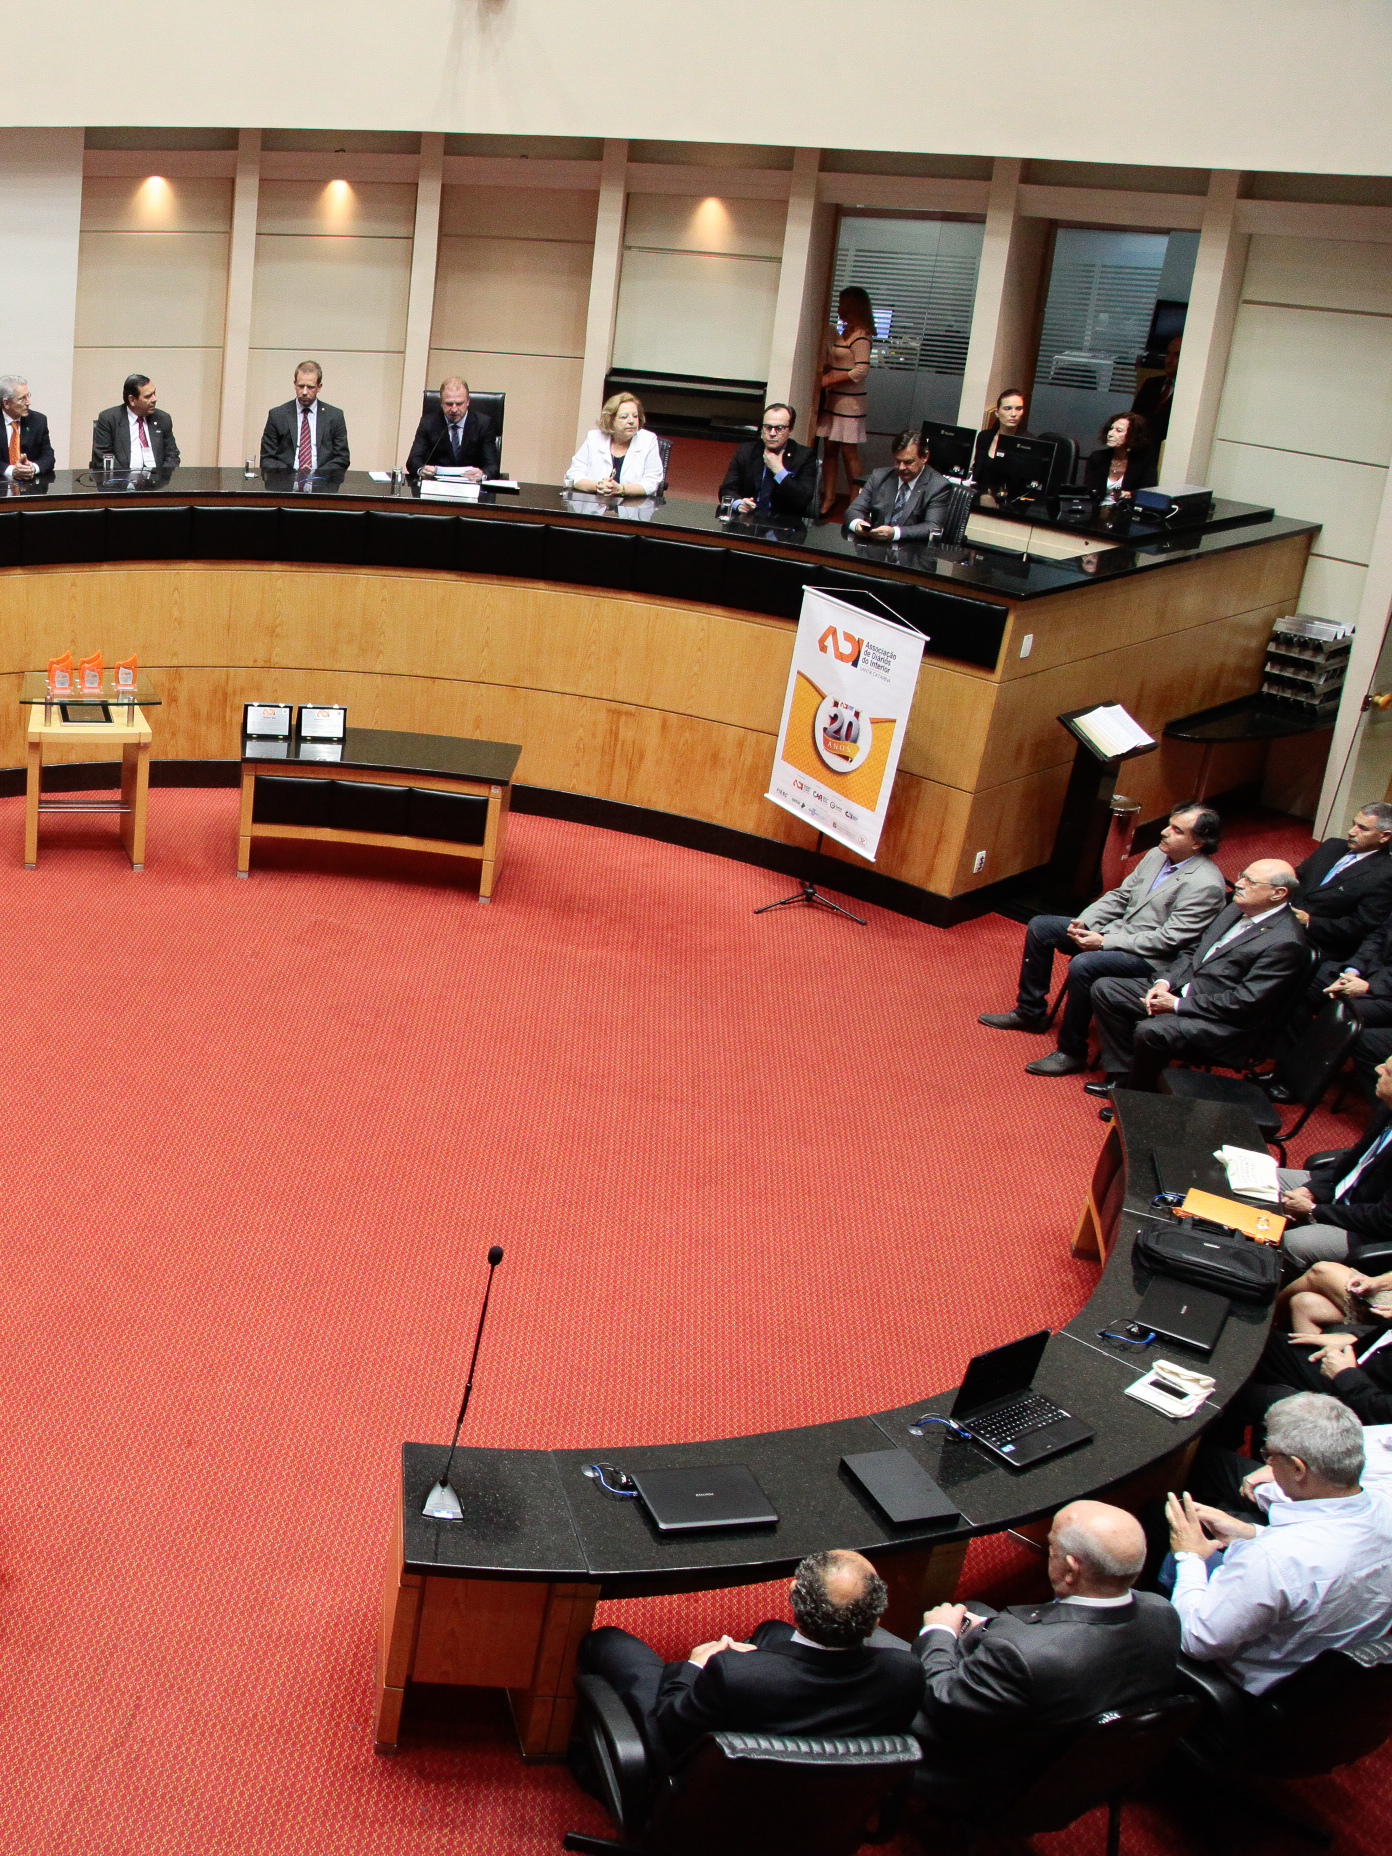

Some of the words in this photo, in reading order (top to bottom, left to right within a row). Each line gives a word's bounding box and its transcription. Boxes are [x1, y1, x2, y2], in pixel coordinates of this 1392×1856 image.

[818, 625, 865, 668] ADI
[865, 641, 897, 661] Associação
[861, 657, 870, 665] do
[869, 659, 891, 674] Interior
[863, 649, 871, 658] de
[871, 652, 892, 667] Diários
[825, 706, 860, 744] 20
[827, 741, 851, 753] ANOS
